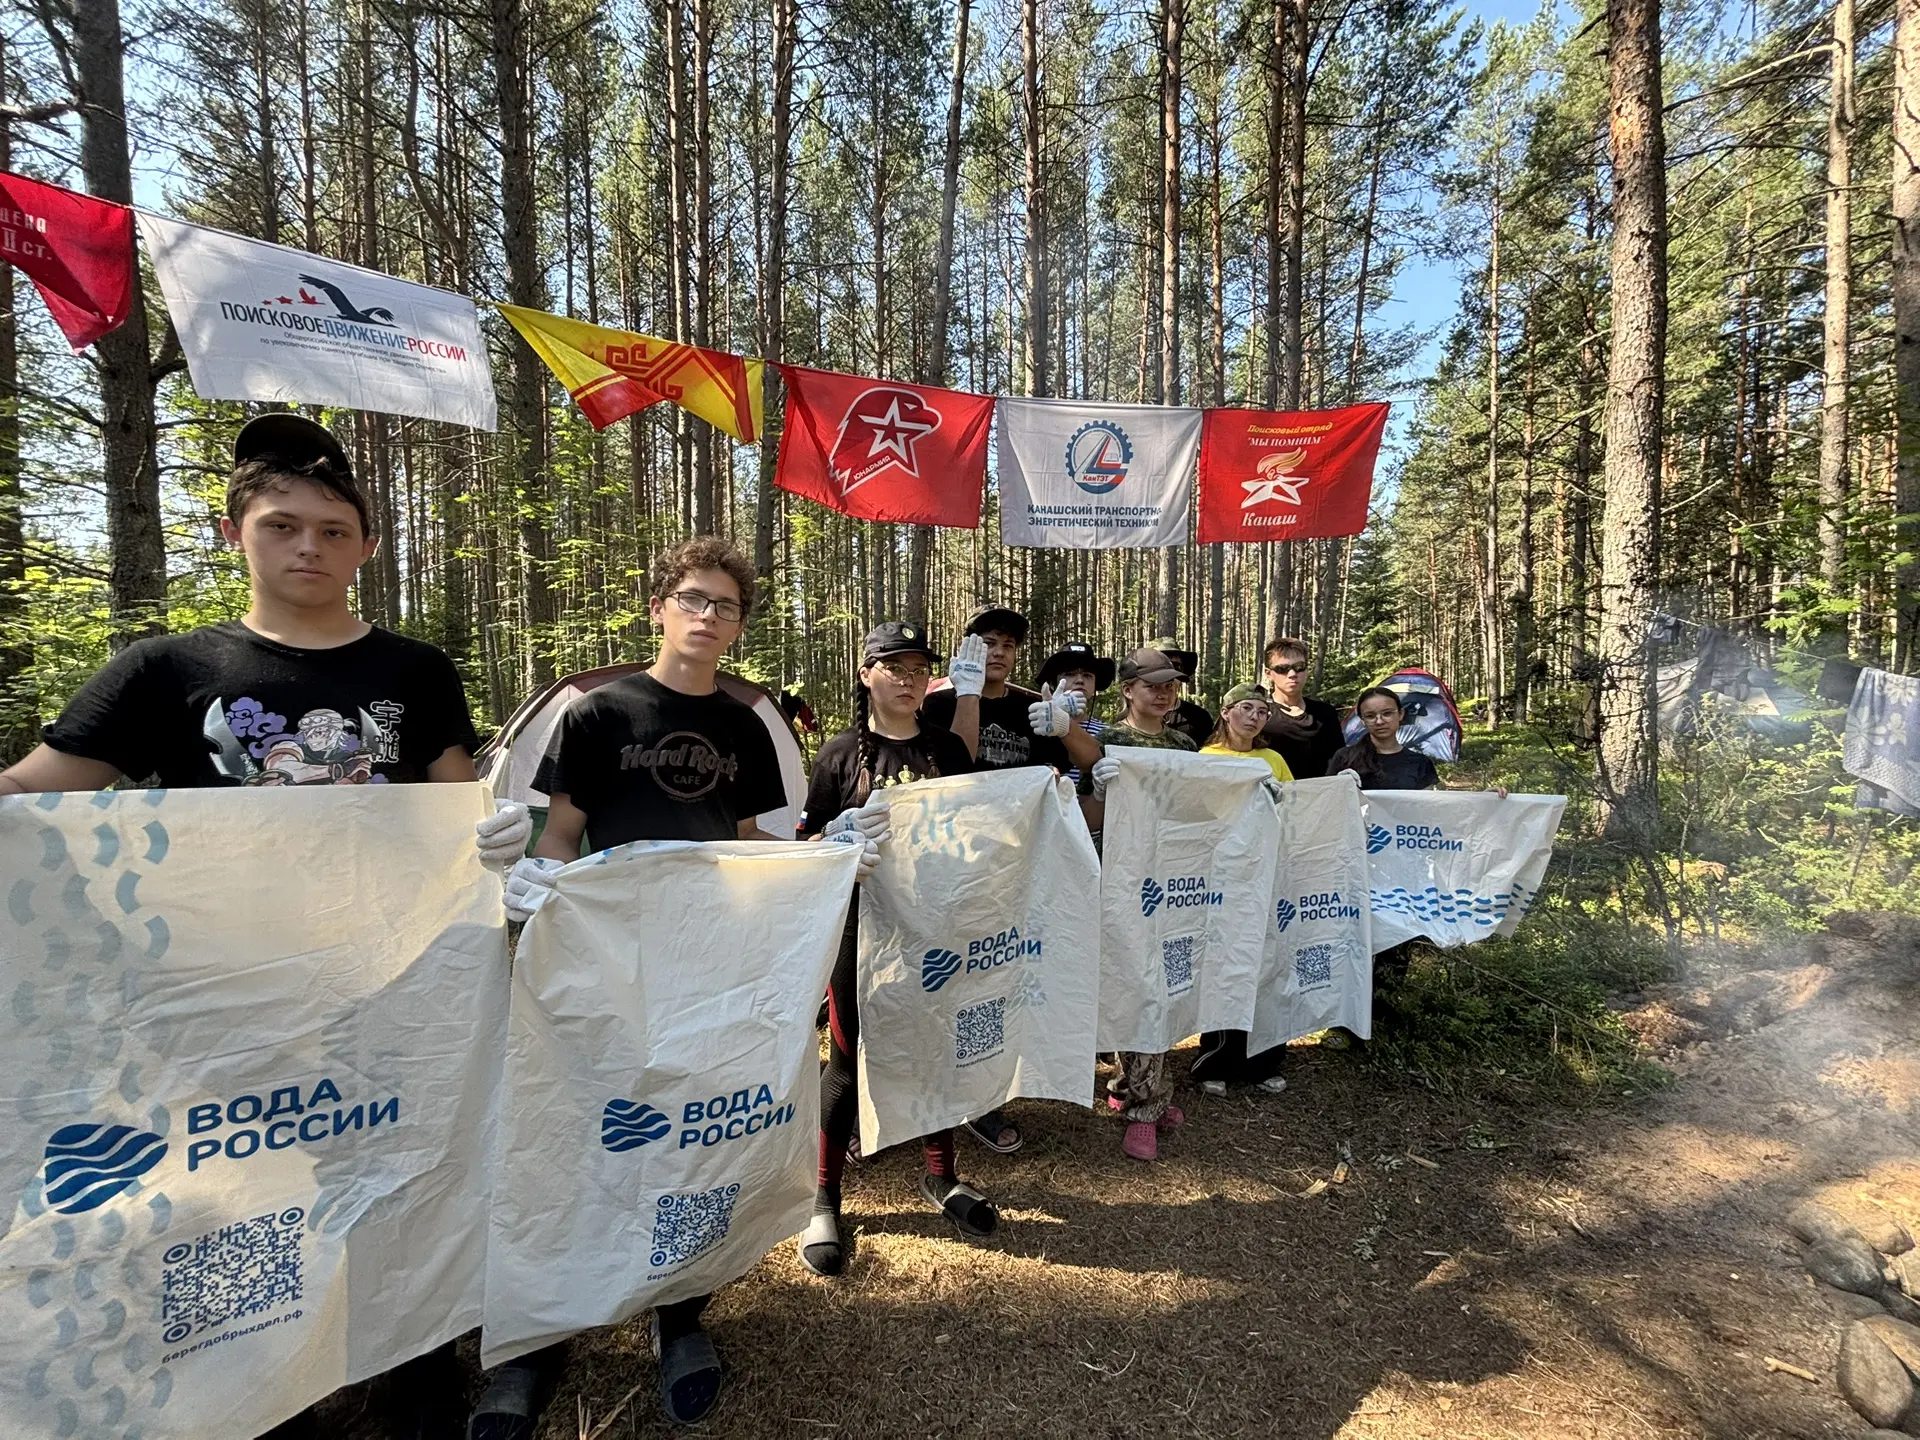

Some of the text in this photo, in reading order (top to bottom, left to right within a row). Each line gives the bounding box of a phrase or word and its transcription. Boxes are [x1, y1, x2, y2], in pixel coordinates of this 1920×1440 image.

[1300, 422, 1333, 434] отряд
[853, 455, 891, 481] ЮНАРМИЯ
[1027, 504, 1092, 516] КАНАШСКИЙ
[1028, 516, 1113, 527] ЭНЕРГЕТИЧЕСКИЙ
[1242, 512, 1297, 526] Канаш
[620, 744, 738, 782] Hard Rock
[673, 774, 701, 785] CAFE
[1396, 825, 1443, 838] ВОДА
[1396, 837, 1463, 852] РОССИИ
[1167, 876, 1205, 893] ВОДА
[1167, 891, 1223, 909] РОССИИ
[1300, 892, 1341, 908] ВОДА
[1300, 906, 1360, 923] РОССИИ
[968, 926, 1019, 956] ВОДА
[966, 940, 1042, 974] РОССИИ
[187, 1078, 343, 1135] ВОДА
[682, 1083, 774, 1124] ВОДА
[187, 1097, 400, 1172] РОССИИ
[161, 1308, 304, 1364] берегдобрыхдел.рф
